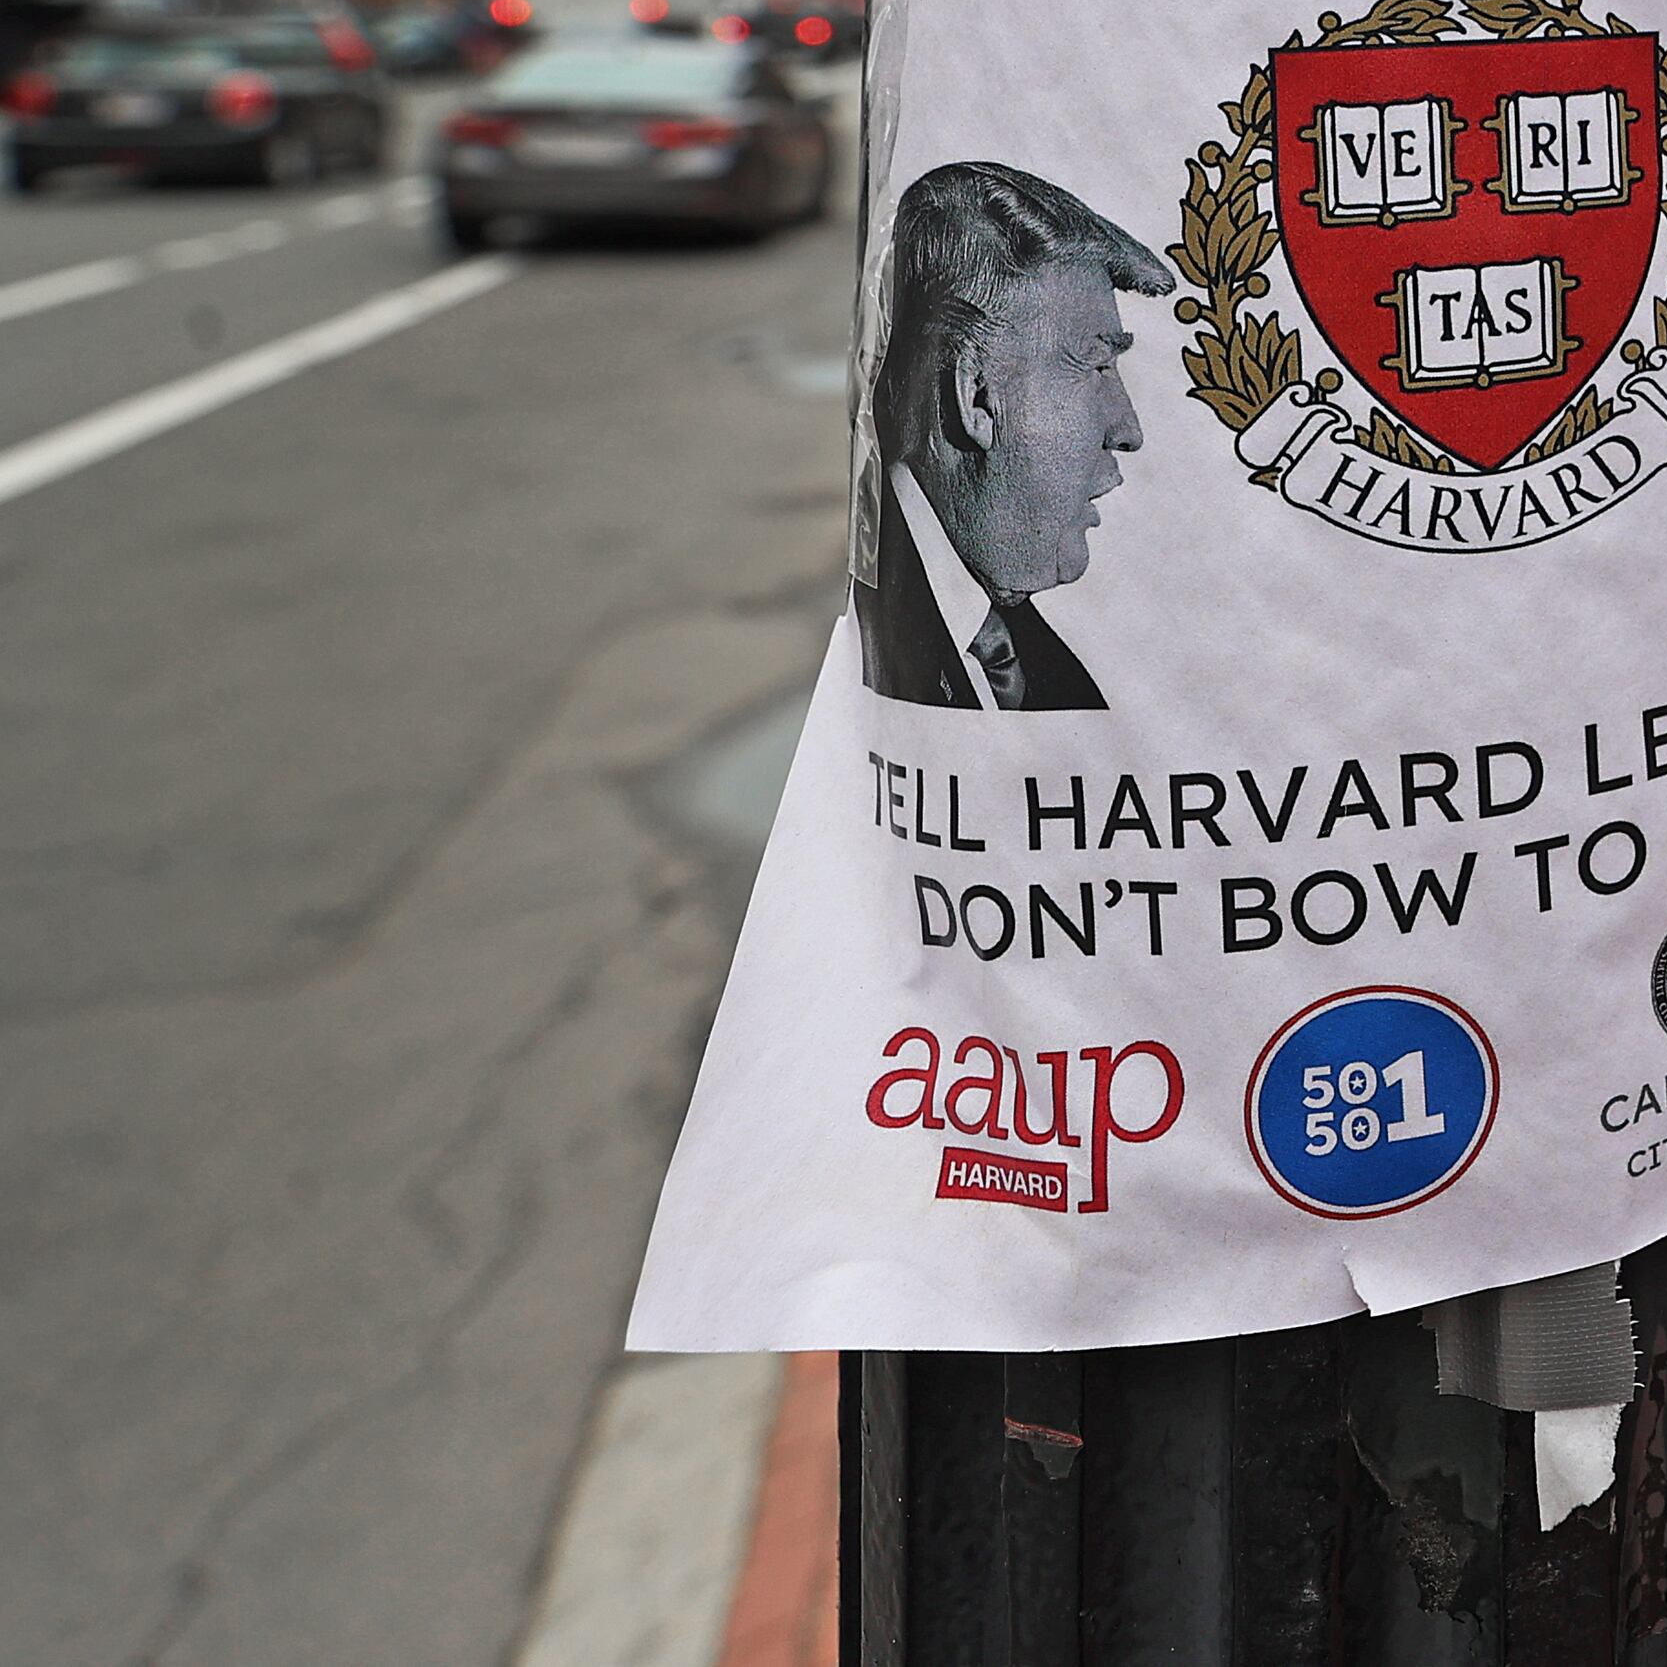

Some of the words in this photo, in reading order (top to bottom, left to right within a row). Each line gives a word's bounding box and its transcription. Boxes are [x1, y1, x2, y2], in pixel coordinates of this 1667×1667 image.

[1340, 132, 1421, 178] VE
[1528, 120, 1591, 168] RI
[1430, 290, 1532, 341] TAS
[1316, 435, 1641, 543] HARVARD
[869, 752, 985, 852] TELL
[1025, 741, 1543, 850] HARVARD
[914, 875, 1177, 961] DON’T
[1221, 852, 1478, 953] BOW
[1514, 821, 1646, 912] TO
[865, 1026, 1185, 1214] aaup
[1384, 1050, 1445, 1142] 1
[947, 1160, 1063, 1200] HARVARD
